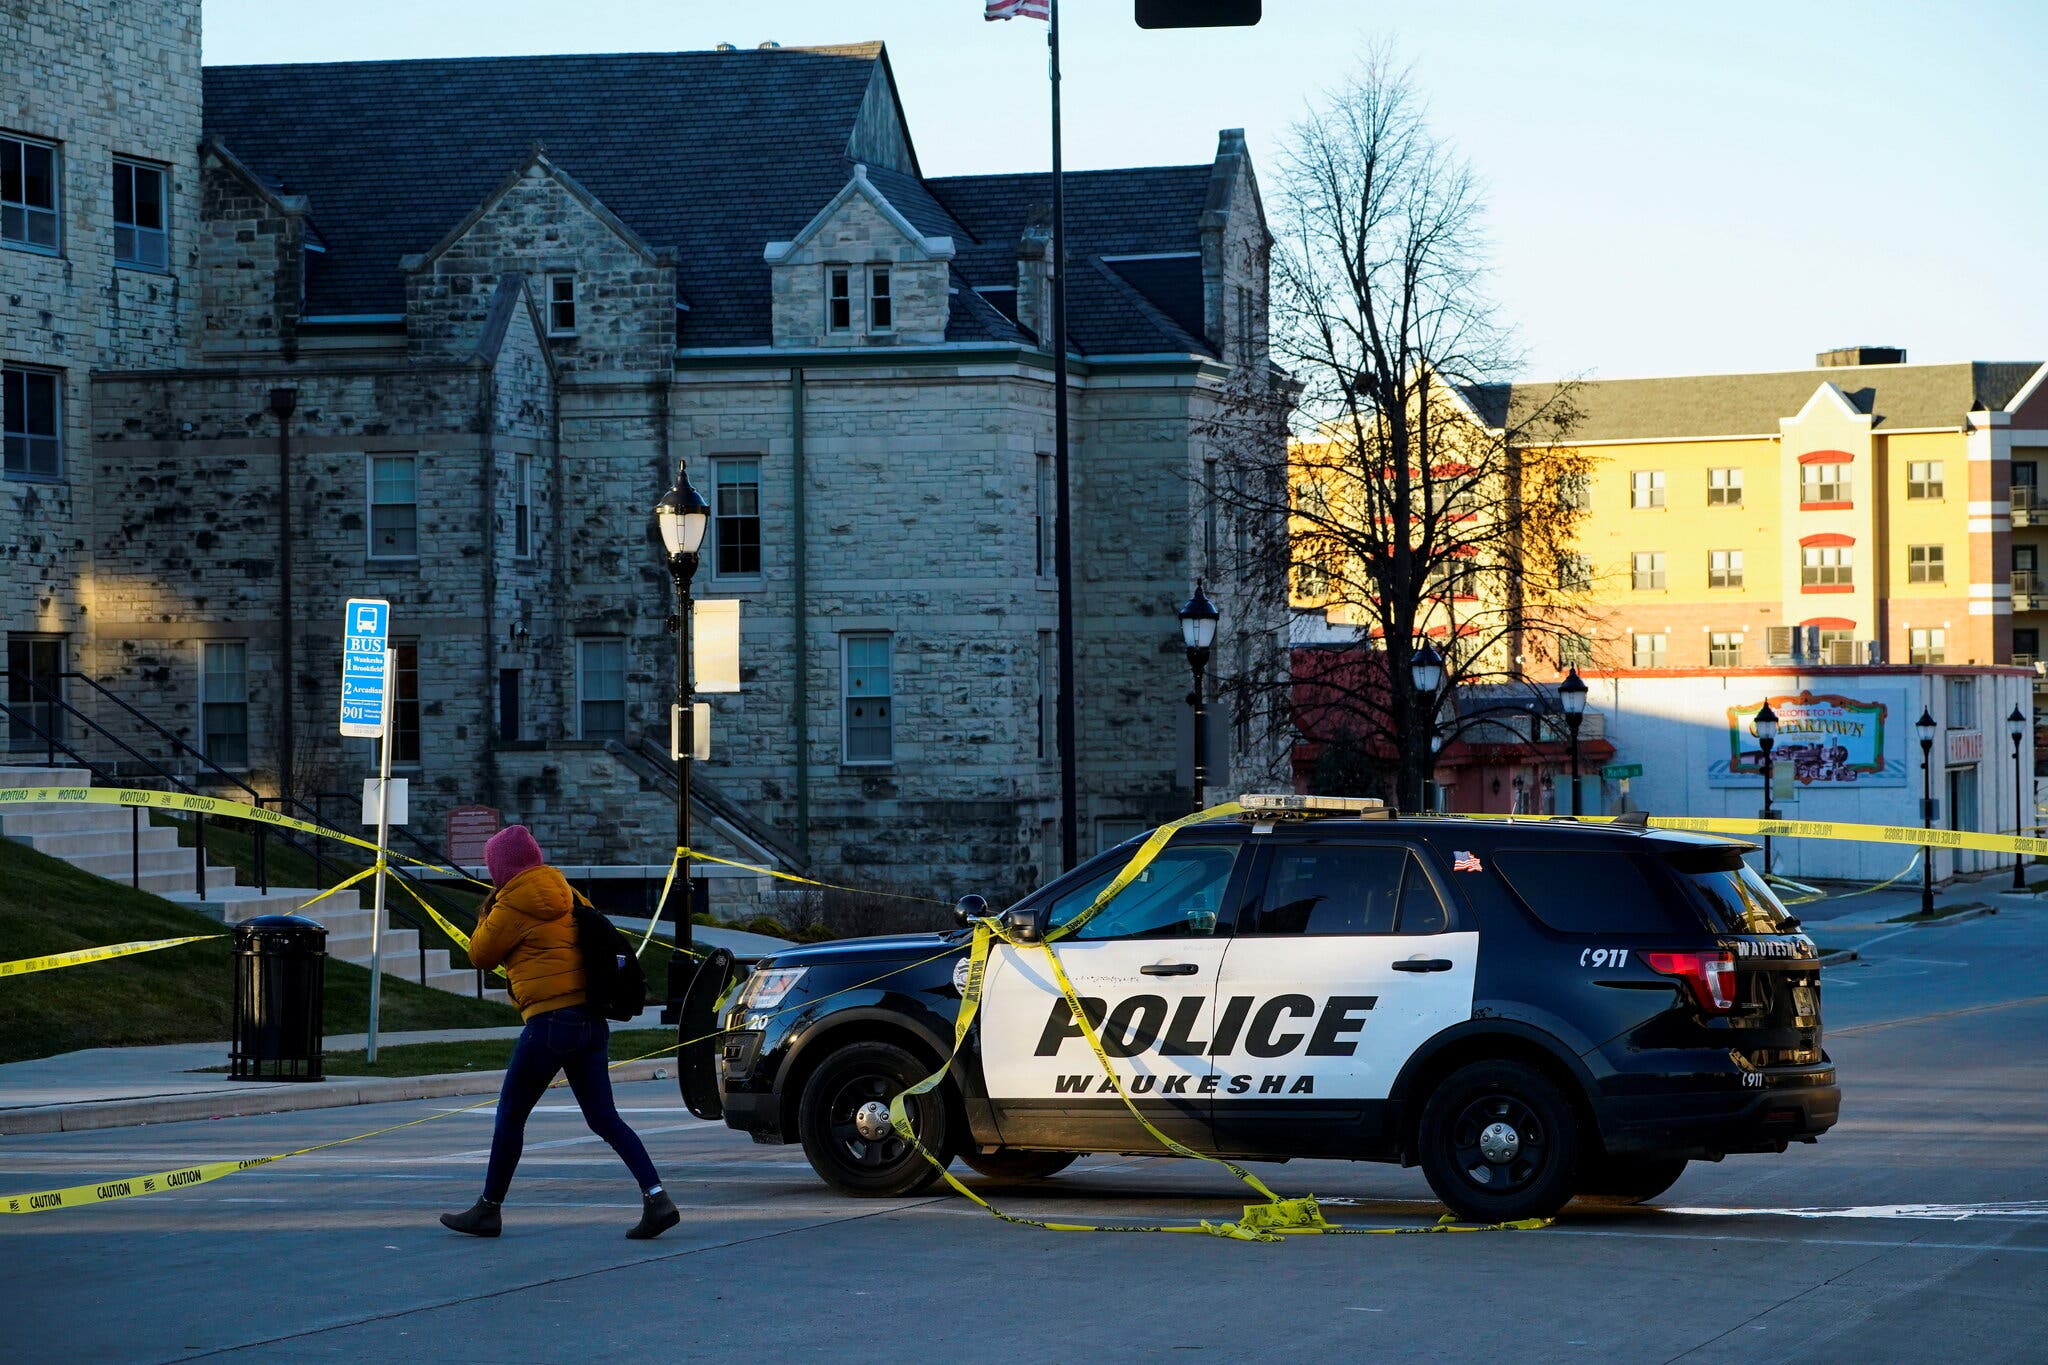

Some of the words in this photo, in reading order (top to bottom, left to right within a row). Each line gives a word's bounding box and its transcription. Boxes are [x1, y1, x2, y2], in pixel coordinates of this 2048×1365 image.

[351, 638, 382, 652] BUS
[345, 658, 352, 671] 1
[353, 656, 384, 664] Waukesha
[344, 682, 352, 695] 2
[352, 686, 384, 694] Arcadian
[342, 706, 364, 719] 901
[1813, 709, 1826, 717] TO
[1828, 709, 1844, 717] THE
[1591, 948, 1629, 968] 911
[748, 1014, 769, 1031] 20
[1033, 993, 1379, 1059] POLICE
[1054, 1074, 1315, 1094] WAUKESHA
[1747, 1072, 1763, 1087] 911
[29, 1193, 62, 1209] CAUTION
[97, 1182, 131, 1199] CAUTION
[166, 1169, 202, 1187] CAUTION
